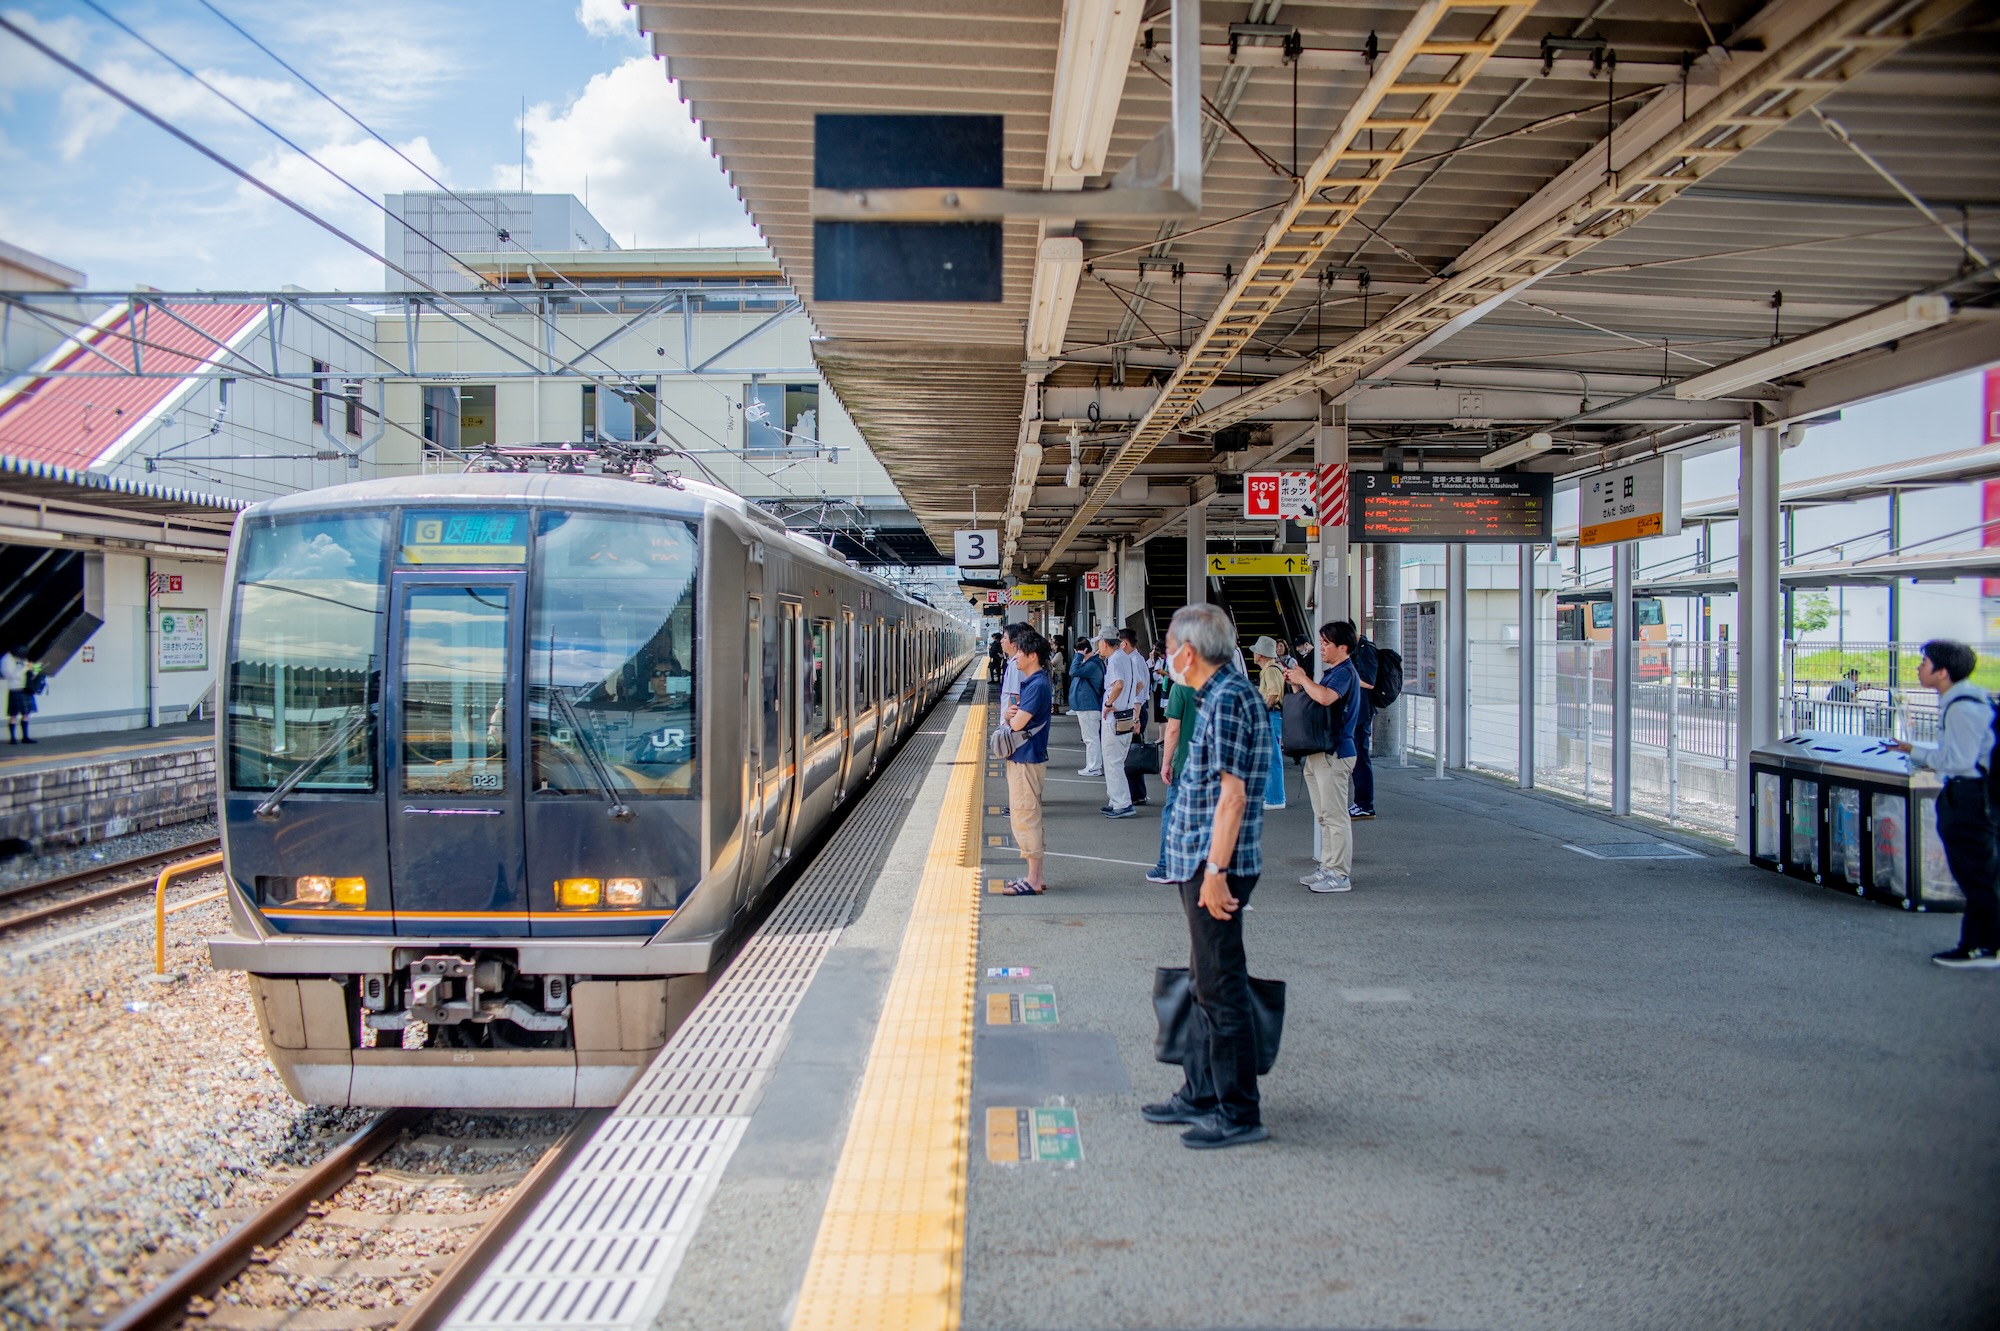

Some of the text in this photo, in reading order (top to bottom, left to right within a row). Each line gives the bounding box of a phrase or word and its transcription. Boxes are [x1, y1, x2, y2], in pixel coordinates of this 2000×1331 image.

[1251, 481, 1276, 491] SOS
[1366, 475, 1376, 489] 3
[1604, 475, 1634, 503] 三田
[1281, 487, 1307, 496] ボタン
[1603, 506, 1616, 518] さんだ
[1620, 503, 1635, 515] Sanda
[422, 523, 437, 540] G
[443, 516, 518, 544] 区間快速
[968, 534, 985, 560] 3
[652, 728, 685, 747] JR
[472, 775, 497, 786] D23
